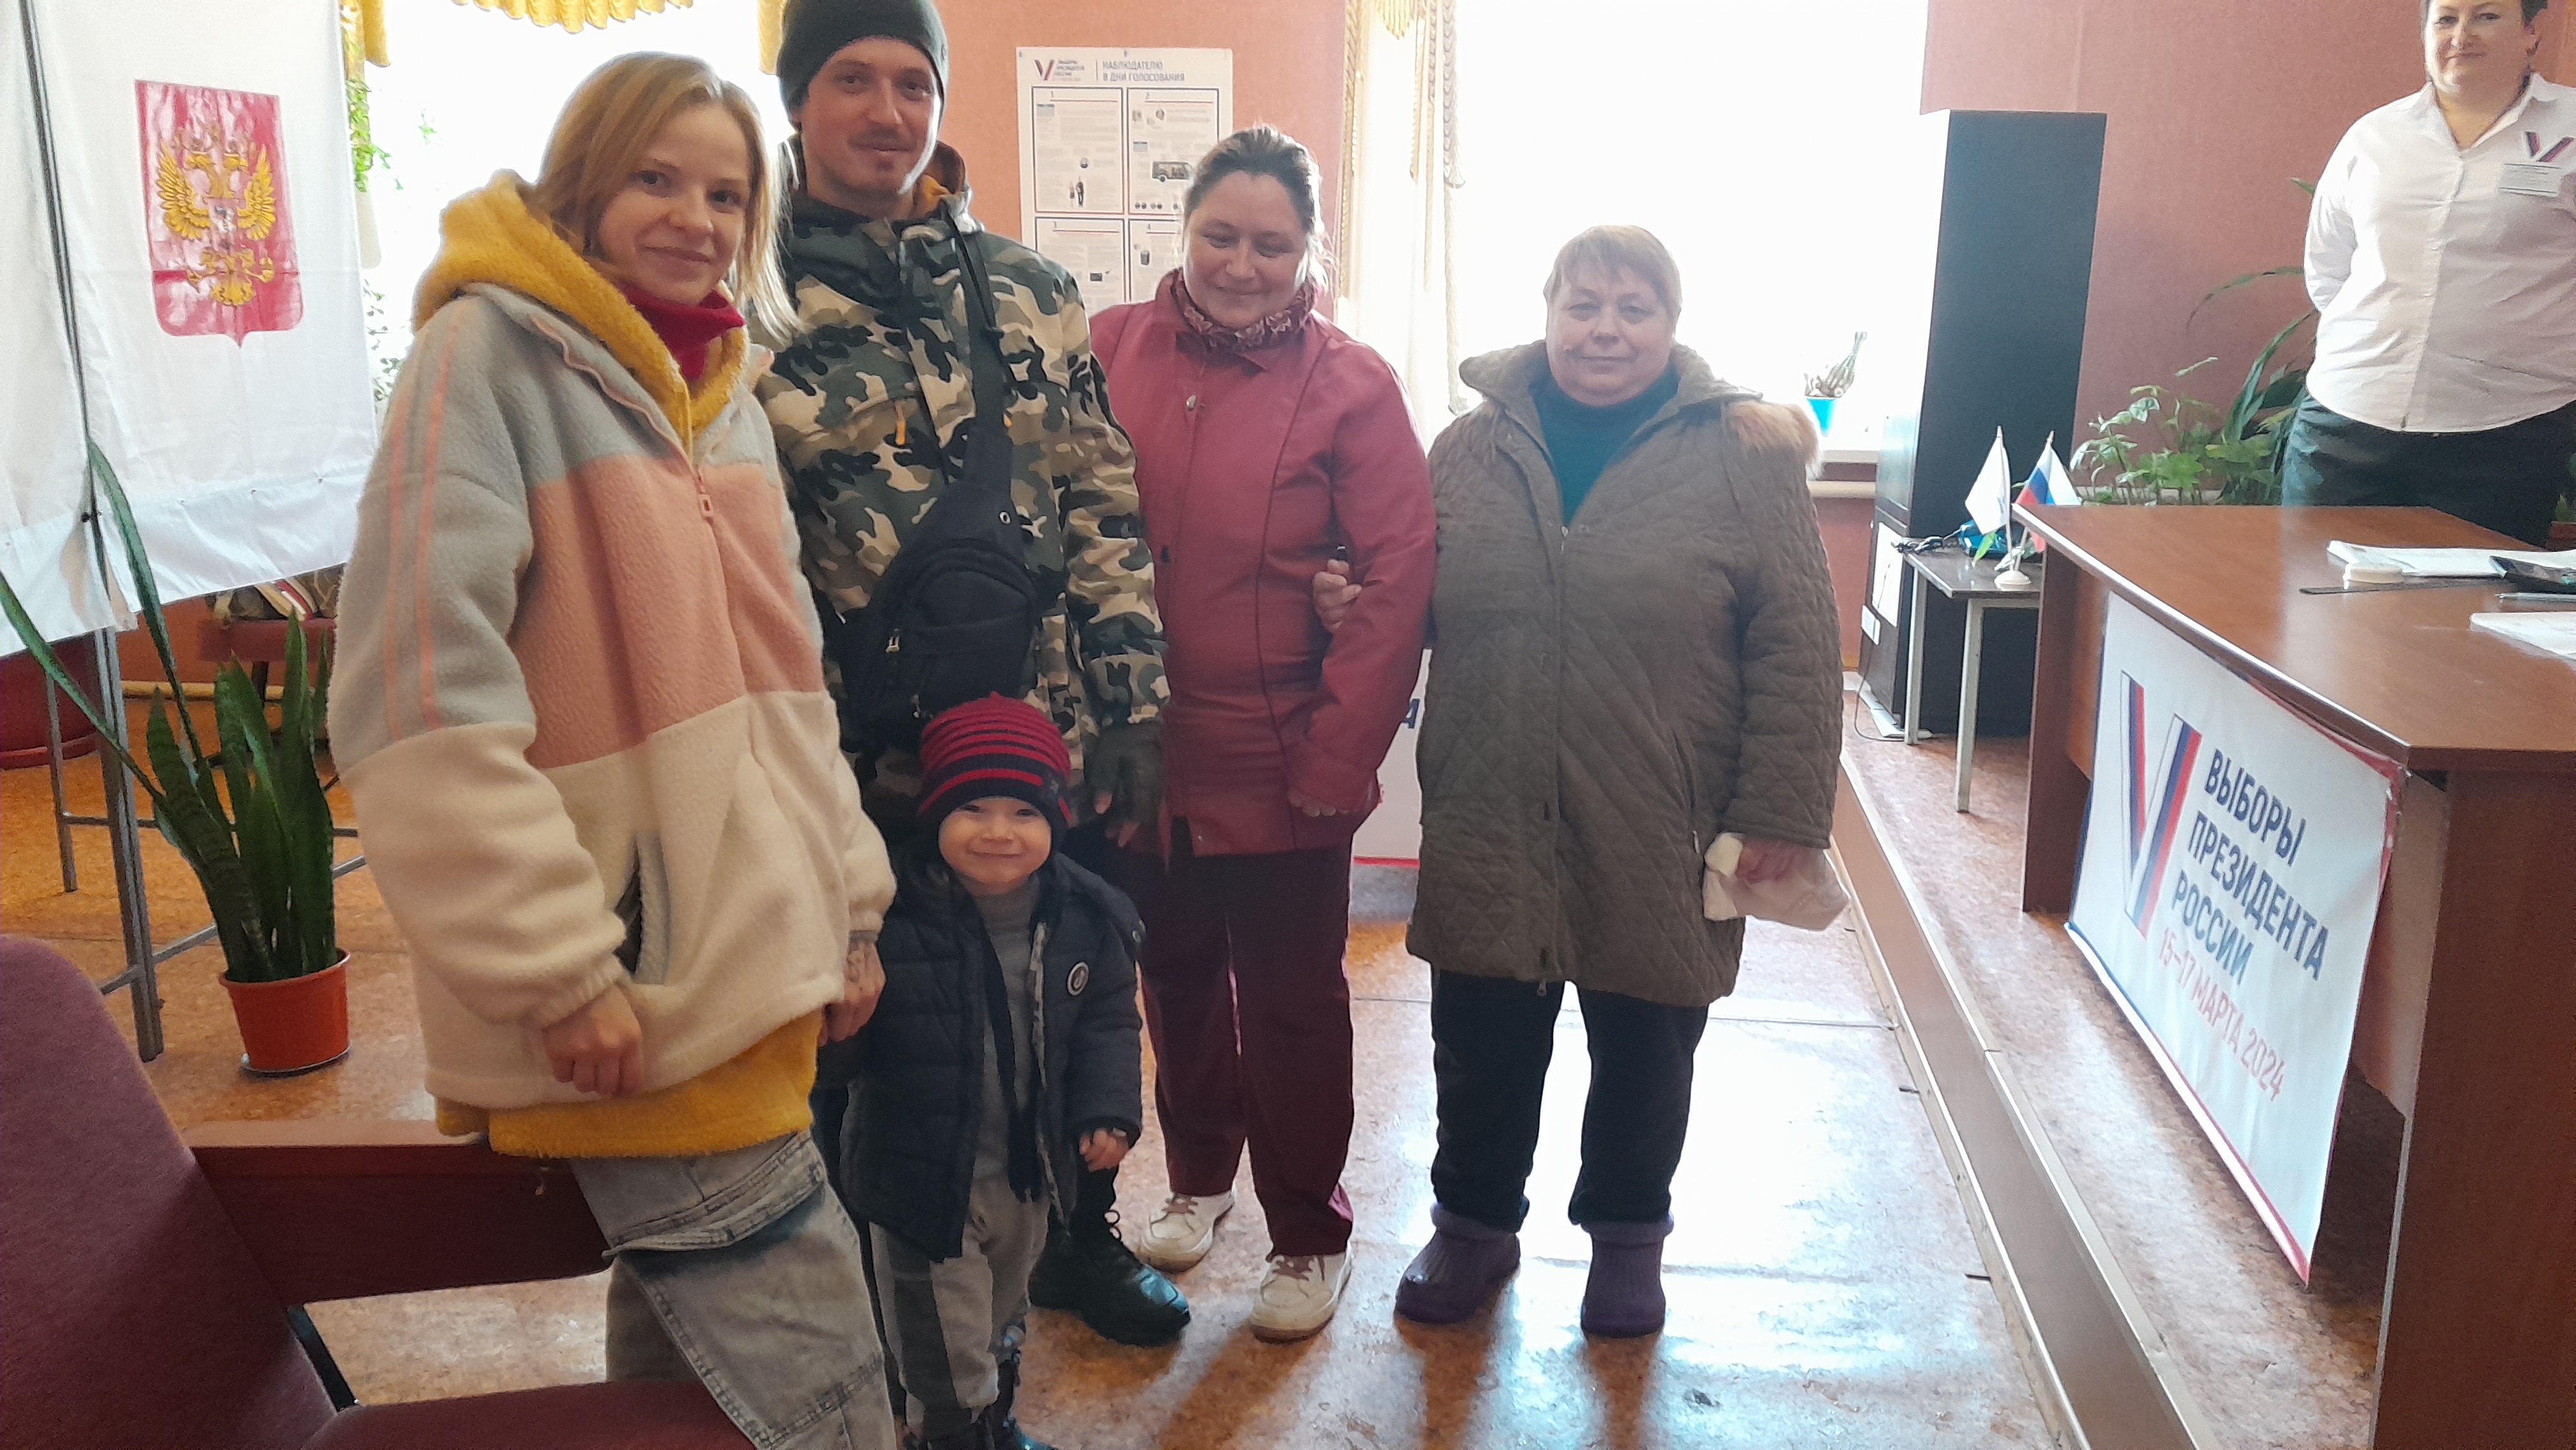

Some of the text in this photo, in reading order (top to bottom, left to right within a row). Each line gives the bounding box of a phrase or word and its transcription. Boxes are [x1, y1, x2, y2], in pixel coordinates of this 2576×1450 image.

[2204, 748, 2306, 867] ВЫБОРЫ
[2172, 869, 2254, 986] РОССИИ
[2188, 810, 2329, 981] ПРЕЗИДЕНТА
[2190, 966, 2245, 1054] МАРТА
[2241, 1027, 2285, 1101] 2024
